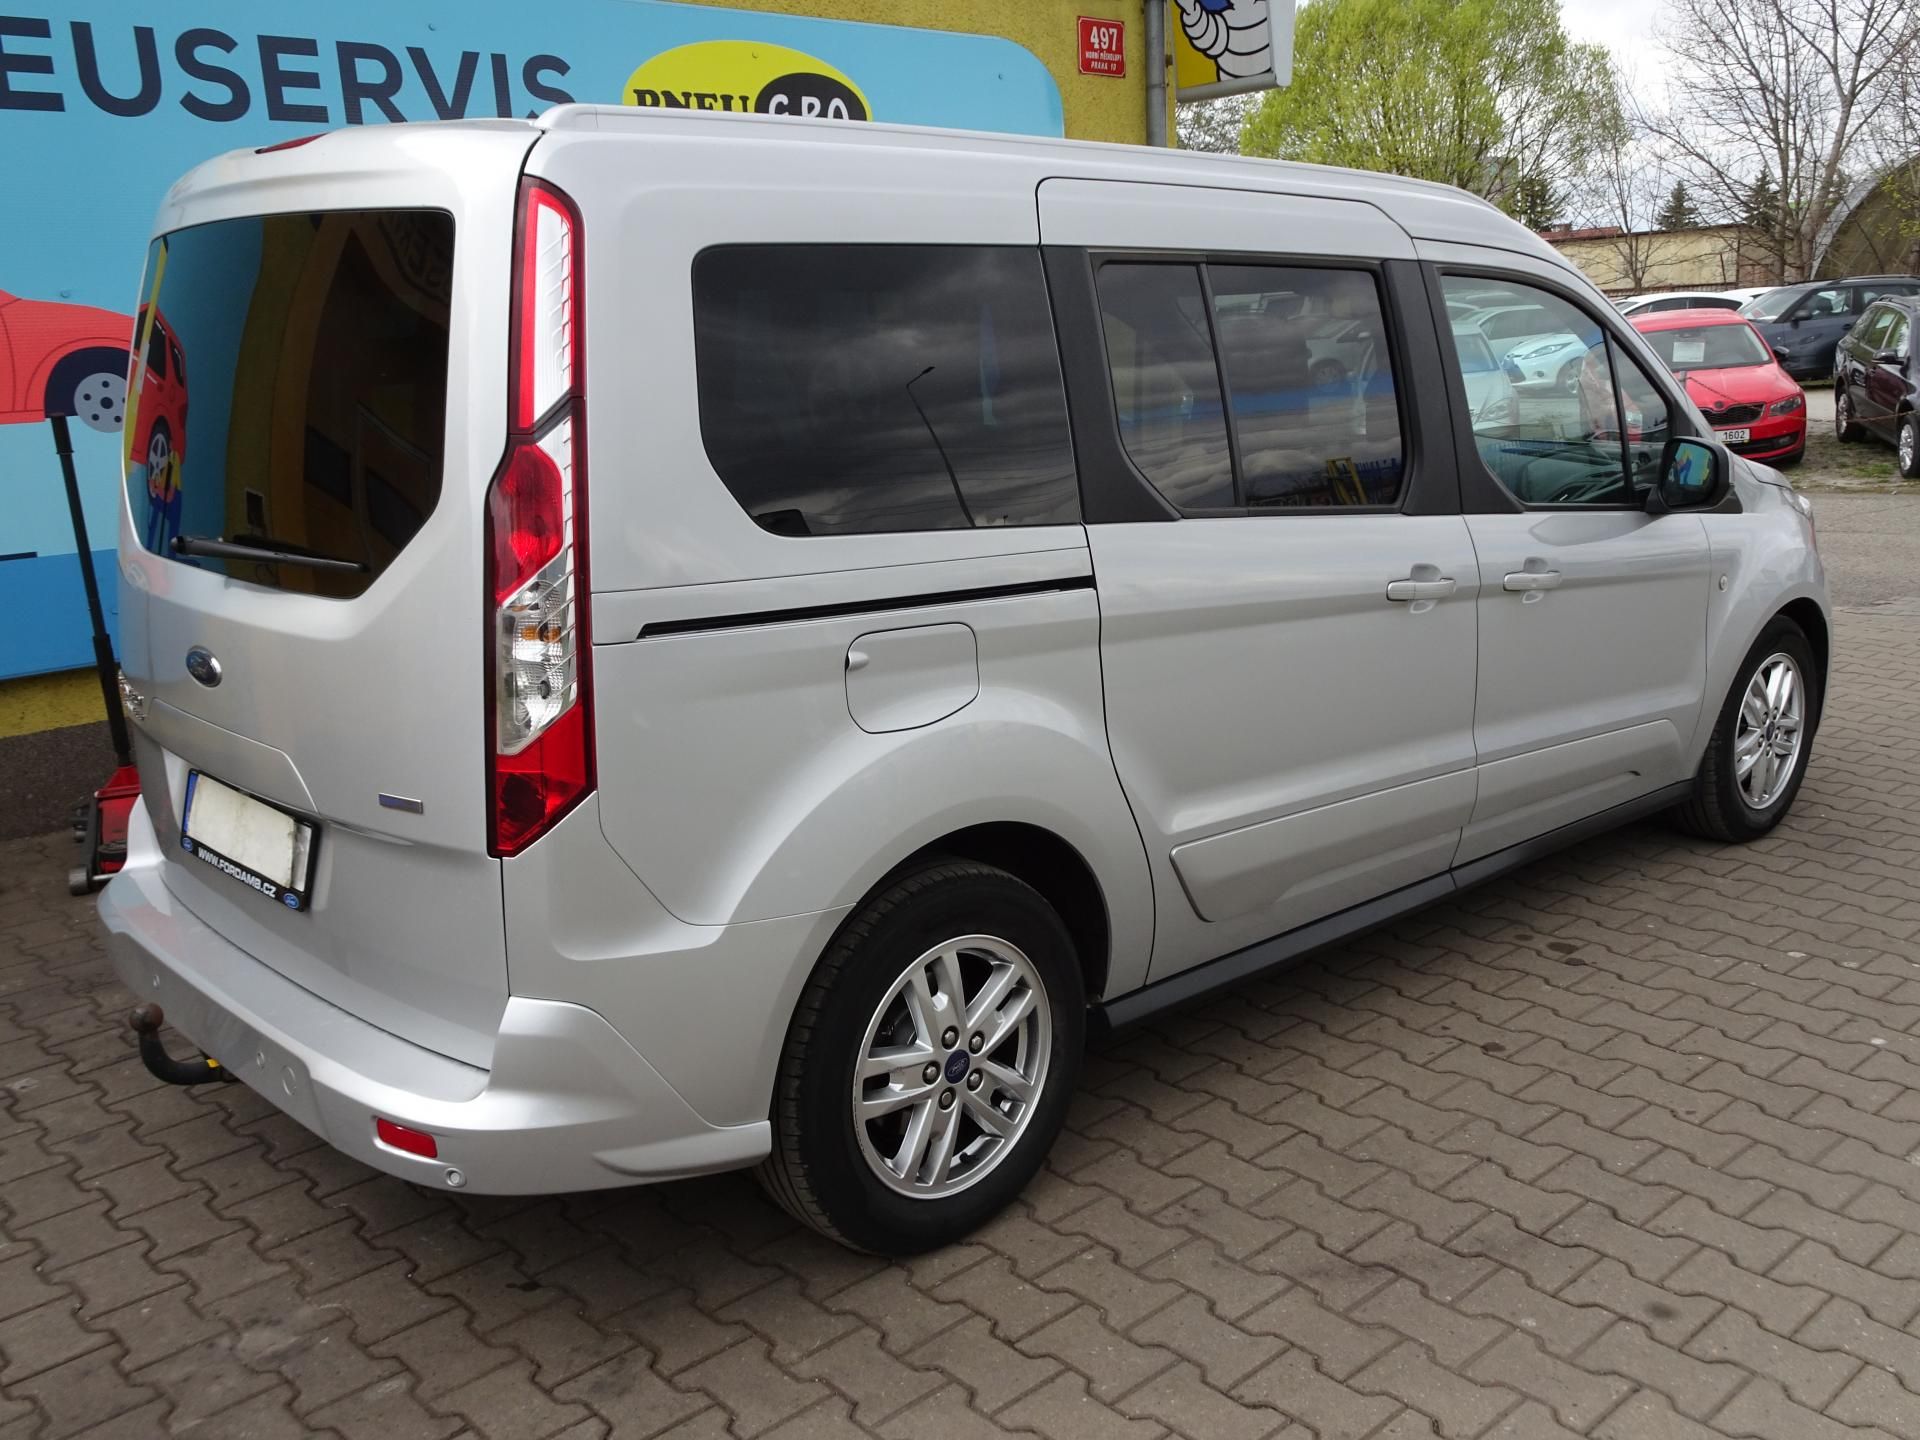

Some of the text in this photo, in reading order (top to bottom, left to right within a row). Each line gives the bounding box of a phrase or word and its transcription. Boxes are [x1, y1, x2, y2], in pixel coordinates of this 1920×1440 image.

[1090, 26, 1118, 51] 497
[0, 16, 576, 124] EUSERVIS
[1723, 430, 1745, 440] 1602
